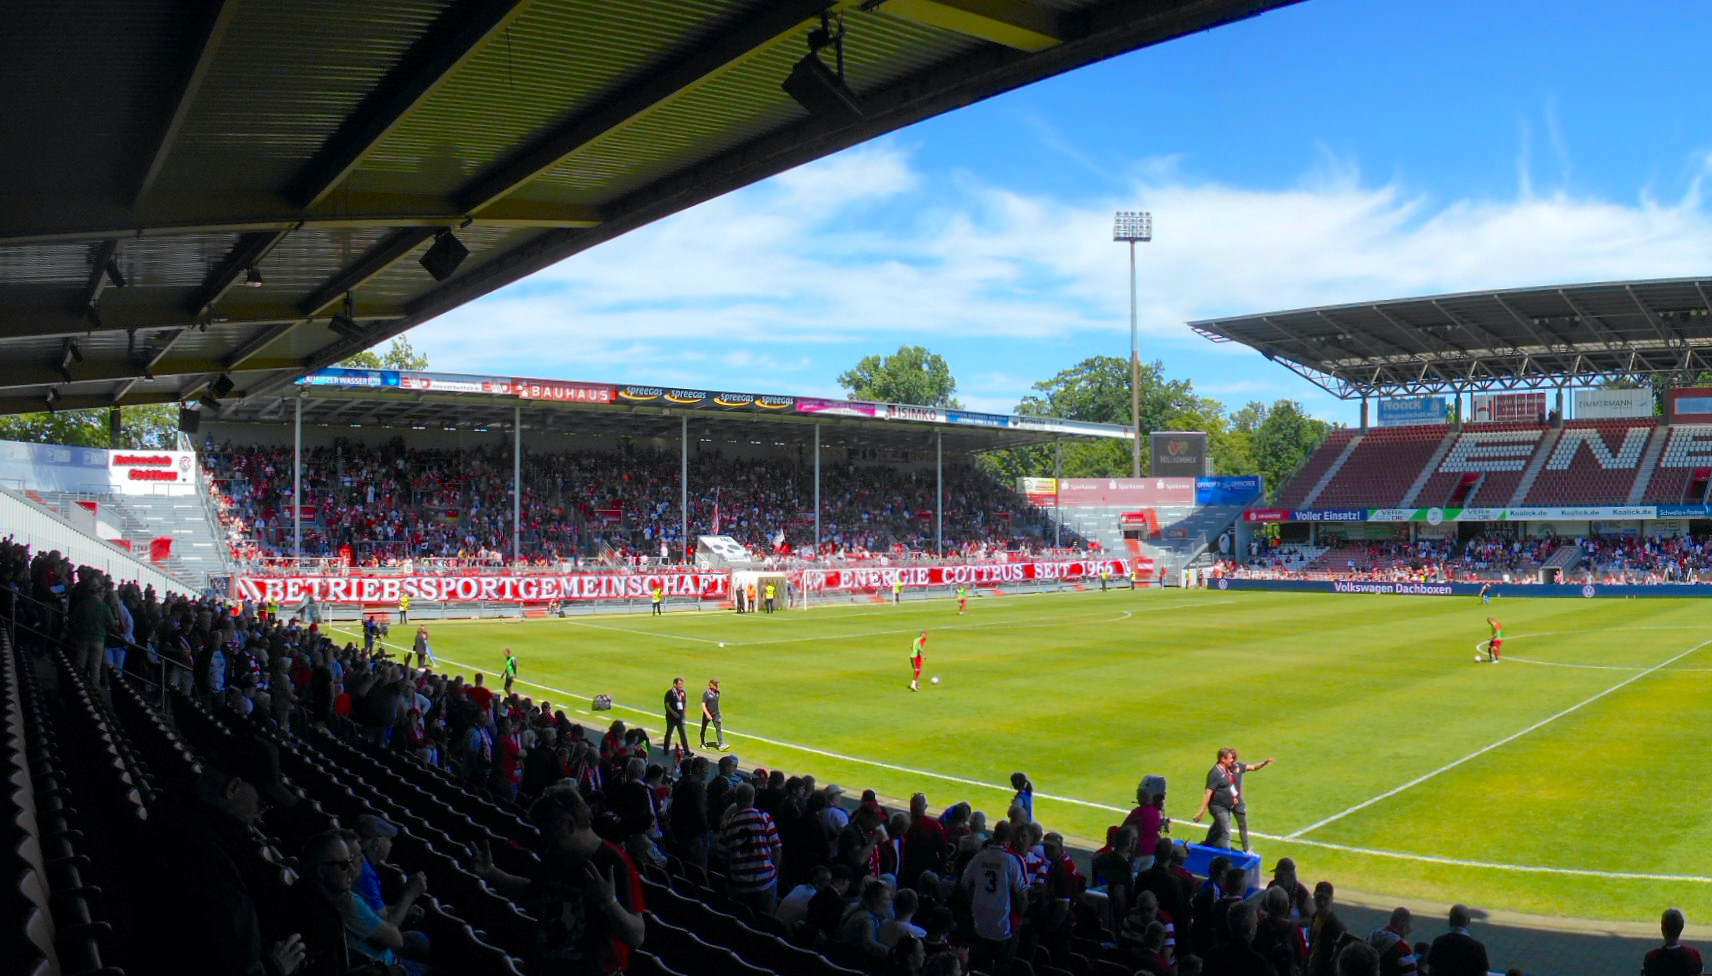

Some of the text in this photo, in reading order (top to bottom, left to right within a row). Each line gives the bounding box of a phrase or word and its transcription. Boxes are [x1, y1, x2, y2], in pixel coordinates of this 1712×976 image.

[531, 385, 609, 401] BAUHAUS
[1383, 400, 1422, 411] Noack
[1578, 399, 1633, 409] ZIMMERMANN
[1159, 455, 1197, 465] WILLKOMMEN
[1070, 483, 1097, 491] Sparkasse
[1118, 482, 1145, 491] Sparkasse
[1165, 482, 1190, 490] Sparkasse
[1295, 511, 1361, 521] Voller Einsatz!
[839, 560, 1114, 588] ENERGIE COTTBUS SEIT 1966
[266, 574, 728, 601] BETRIEBSSPORTGEMEINSCHAFT
[1334, 581, 1453, 595] Volkswagen Dachboxen
[984, 870, 996, 893] 3
